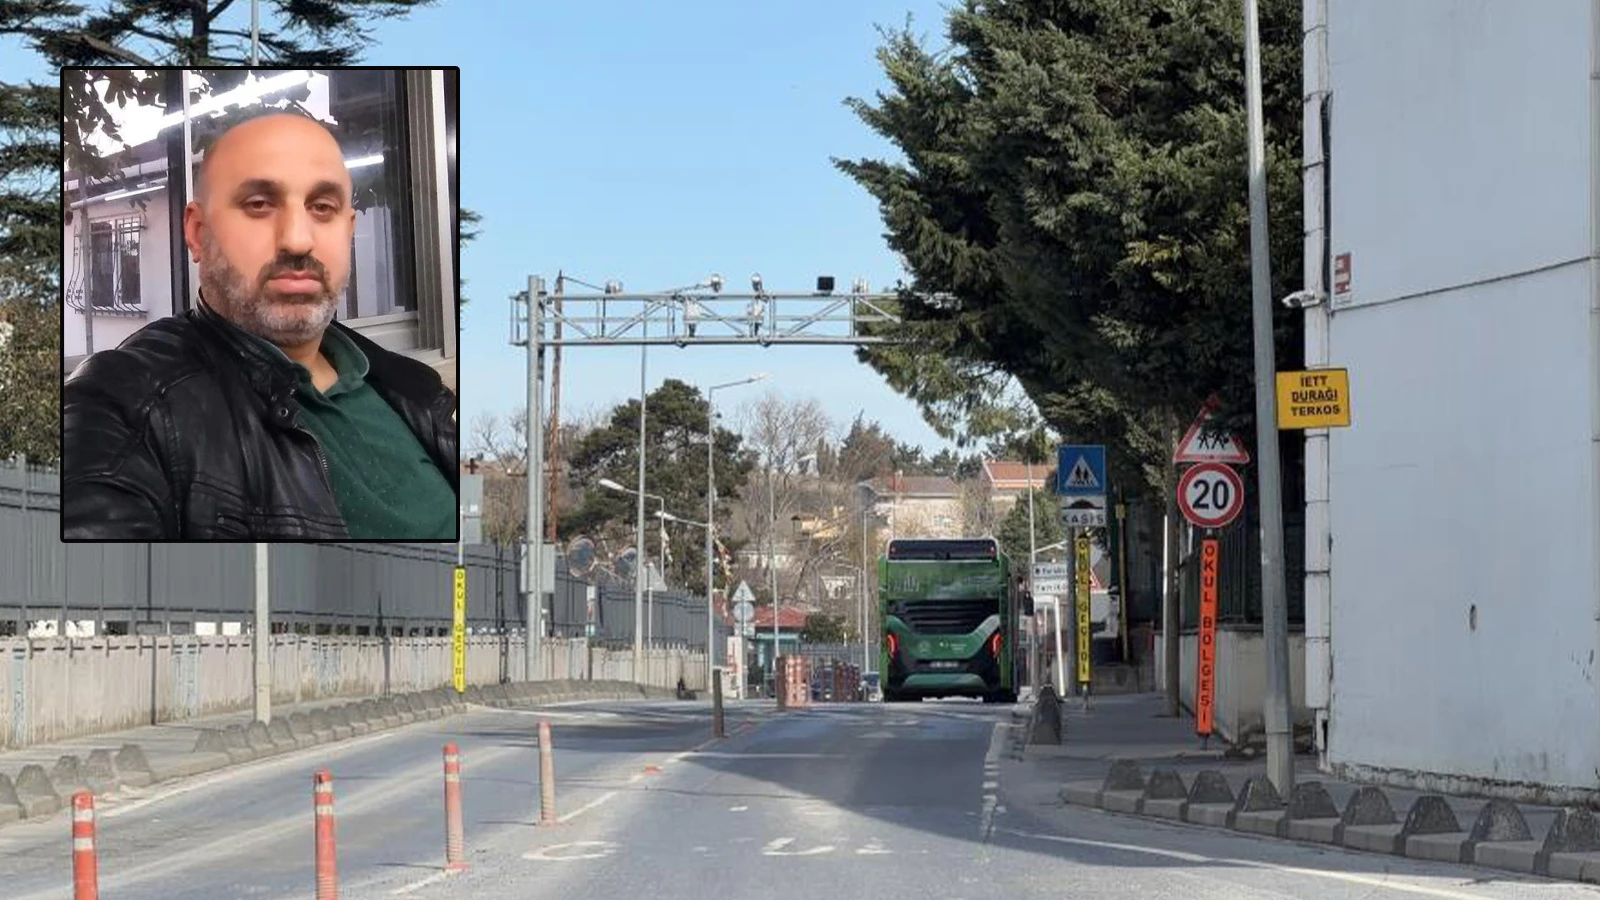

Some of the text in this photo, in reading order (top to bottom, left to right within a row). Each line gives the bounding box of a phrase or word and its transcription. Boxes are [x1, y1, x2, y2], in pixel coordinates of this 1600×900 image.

[1292, 387, 1338, 403] DURAĞI
[1291, 405, 1340, 416] TERKOS
[1192, 479, 1230, 510] 20
[1204, 544, 1215, 603] OKUL
